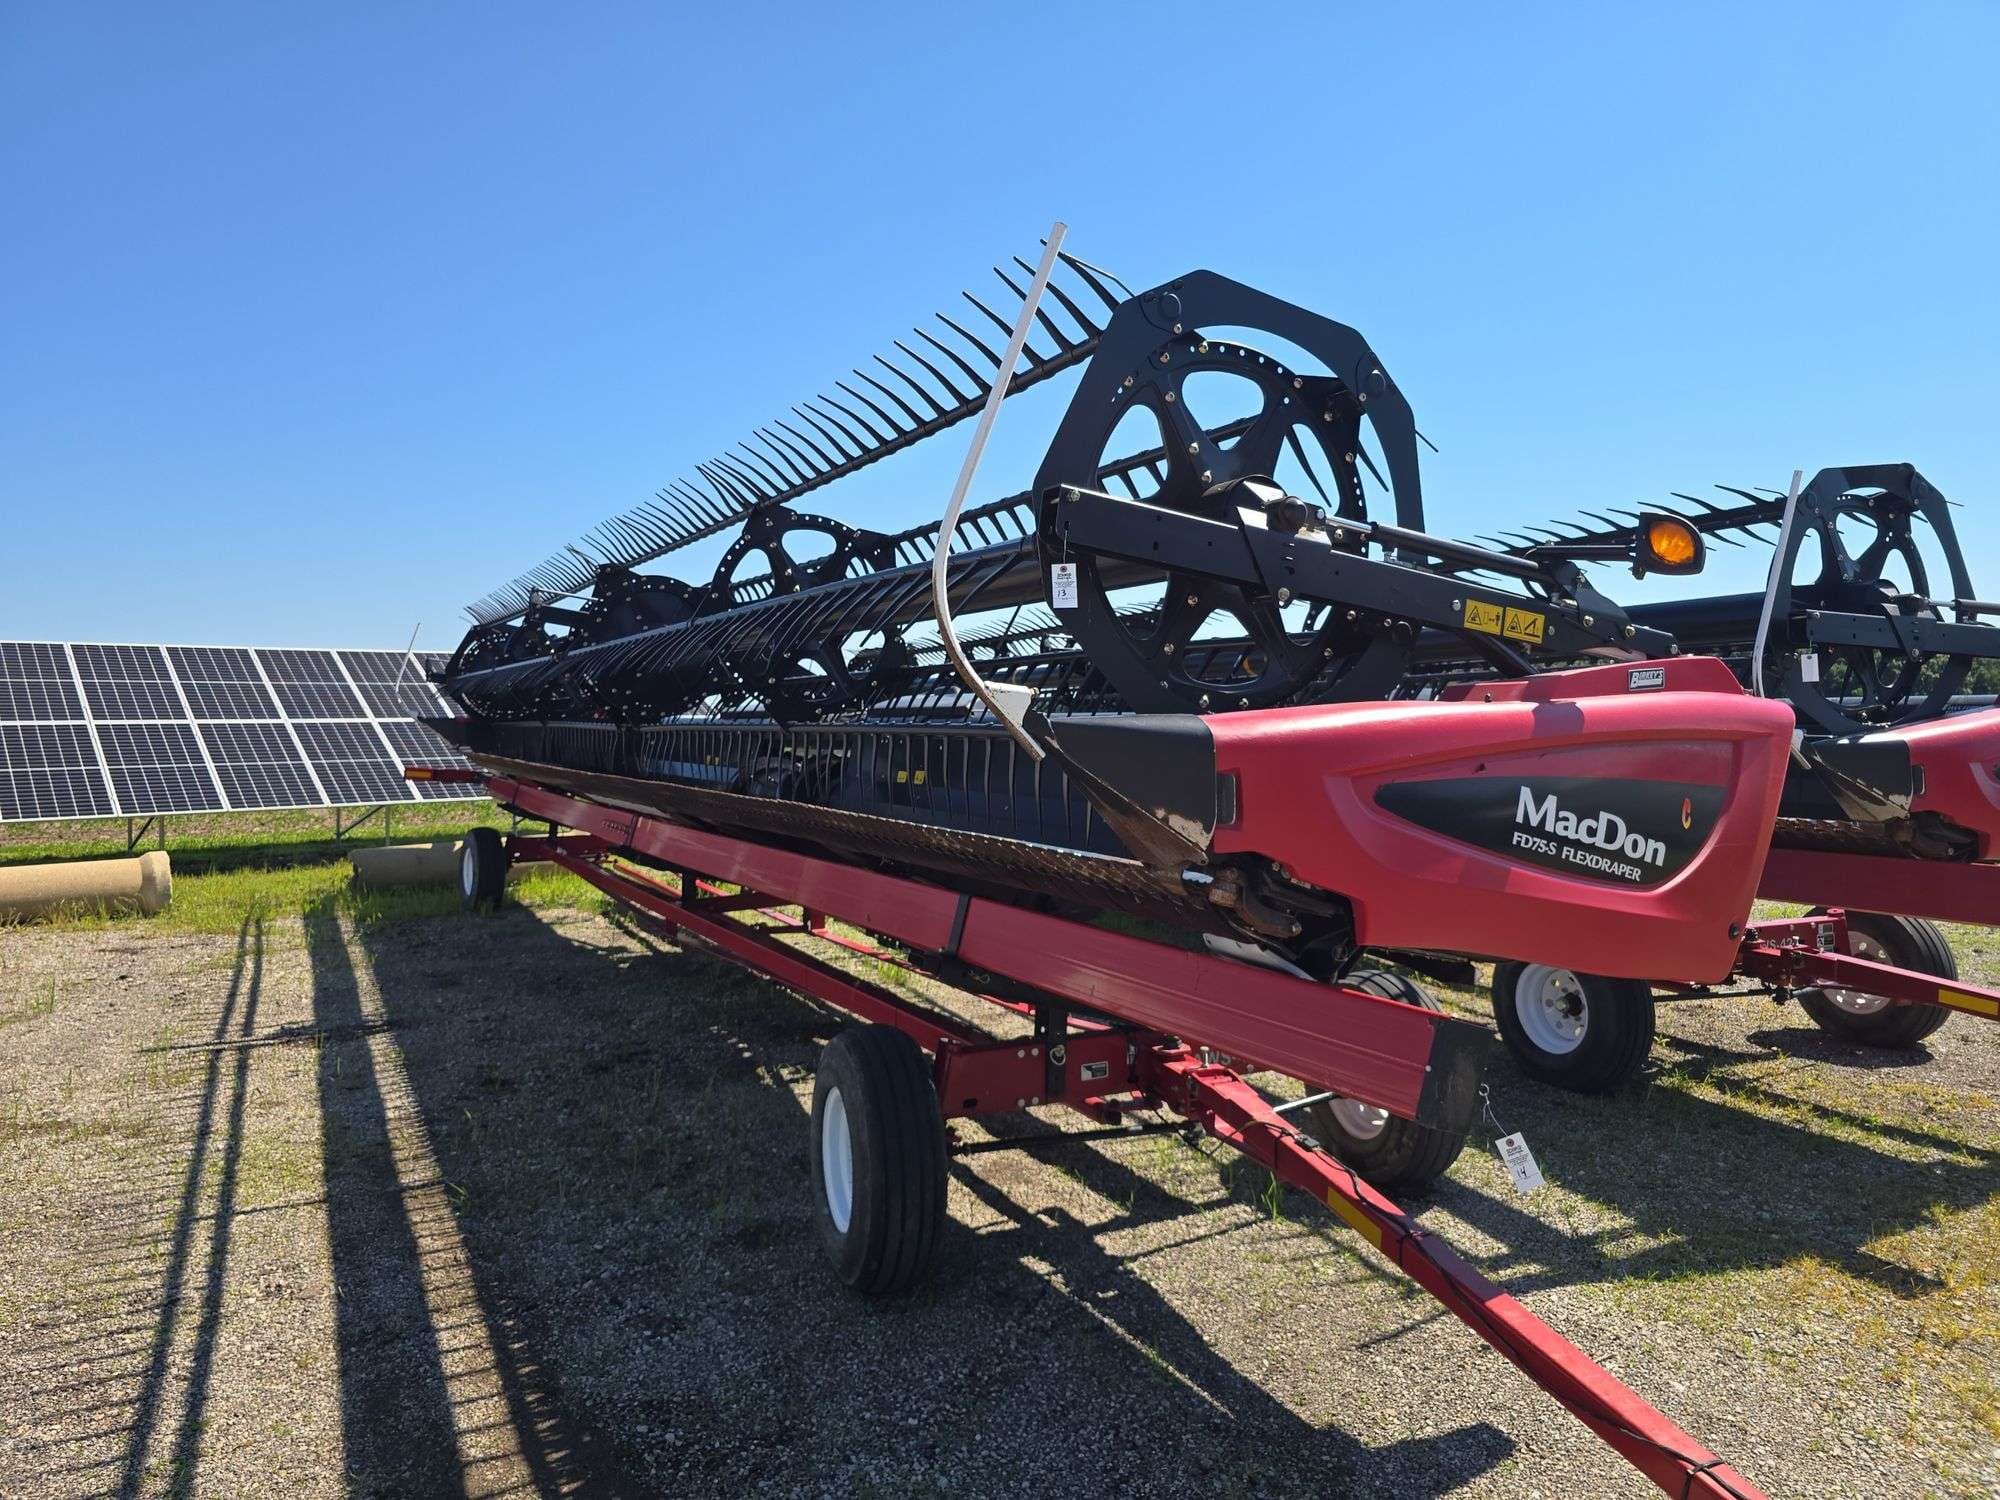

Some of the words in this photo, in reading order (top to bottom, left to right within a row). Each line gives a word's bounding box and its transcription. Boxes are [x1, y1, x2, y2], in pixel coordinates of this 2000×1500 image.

[1515, 785, 1667, 867] MacDon
[1512, 831, 1557, 856] FD75-S
[1561, 846, 1642, 882] FLEXDRAPER
[1516, 1165, 1527, 1178] 14
